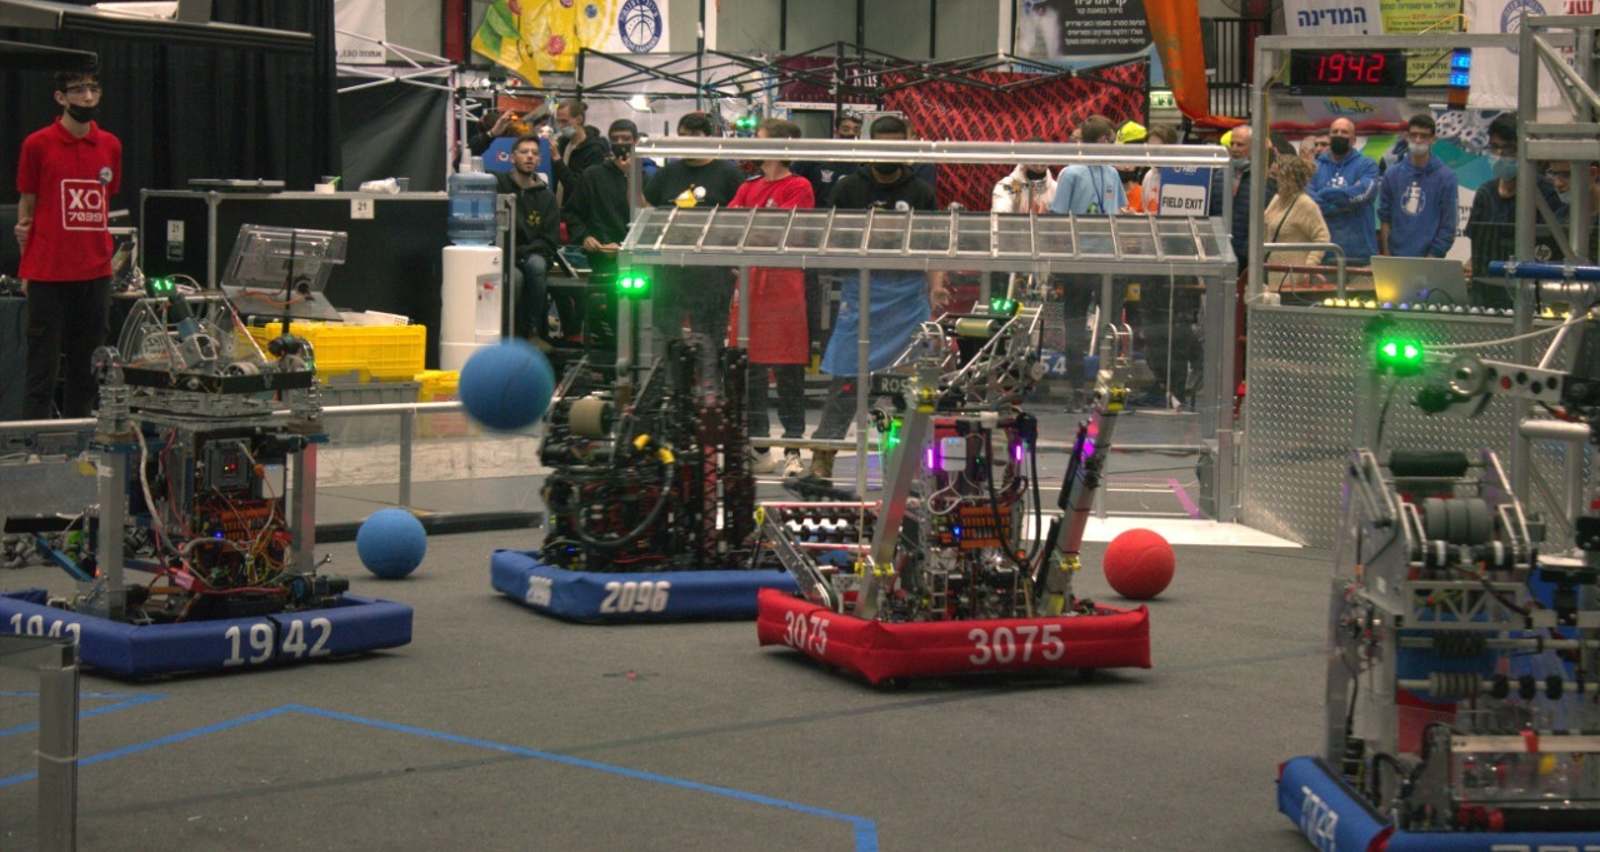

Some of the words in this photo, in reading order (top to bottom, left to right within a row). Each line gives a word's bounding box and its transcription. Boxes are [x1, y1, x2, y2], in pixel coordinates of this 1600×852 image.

[1298, 7, 1367, 27] המדינה
[1317, 53, 1385, 84] 1942
[68, 189, 102, 209] XO
[357, 202, 368, 211] 21
[1161, 196, 1184, 209] FIELD
[1185, 197, 1204, 210] EXIT
[67, 212, 103, 222] 7039
[600, 580, 672, 614] 2096
[223, 617, 333, 668] 1942
[784, 611, 831, 656] 3075
[967, 624, 1066, 667] 3075
